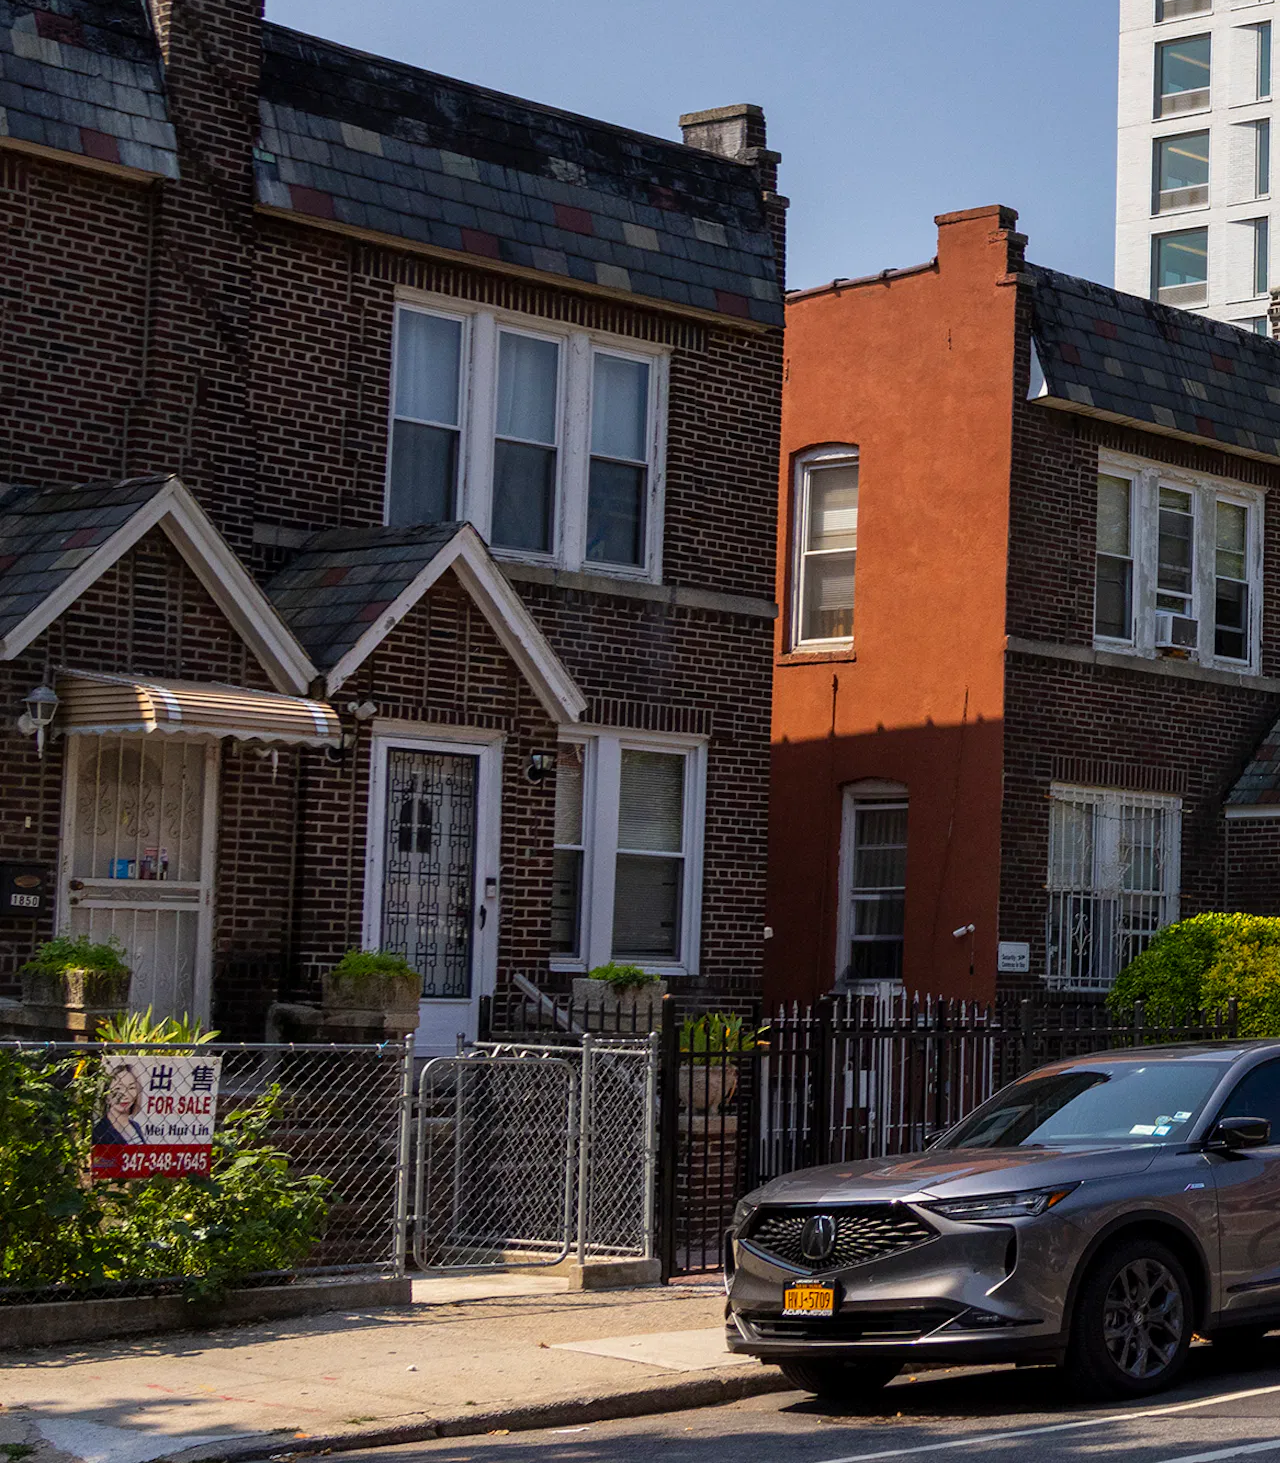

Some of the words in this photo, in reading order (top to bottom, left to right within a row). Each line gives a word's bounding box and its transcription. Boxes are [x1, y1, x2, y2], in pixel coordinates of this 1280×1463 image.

[13, 895, 38, 906] 1850
[149, 1064, 215, 1092] 出售
[147, 1096, 174, 1114] FOR
[177, 1096, 211, 1114] SALE
[144, 1124, 164, 1136] Mei
[168, 1124, 188, 1136] Hui
[191, 1124, 209, 1136] Lin
[121, 1152, 207, 1172] 347-348-7645
